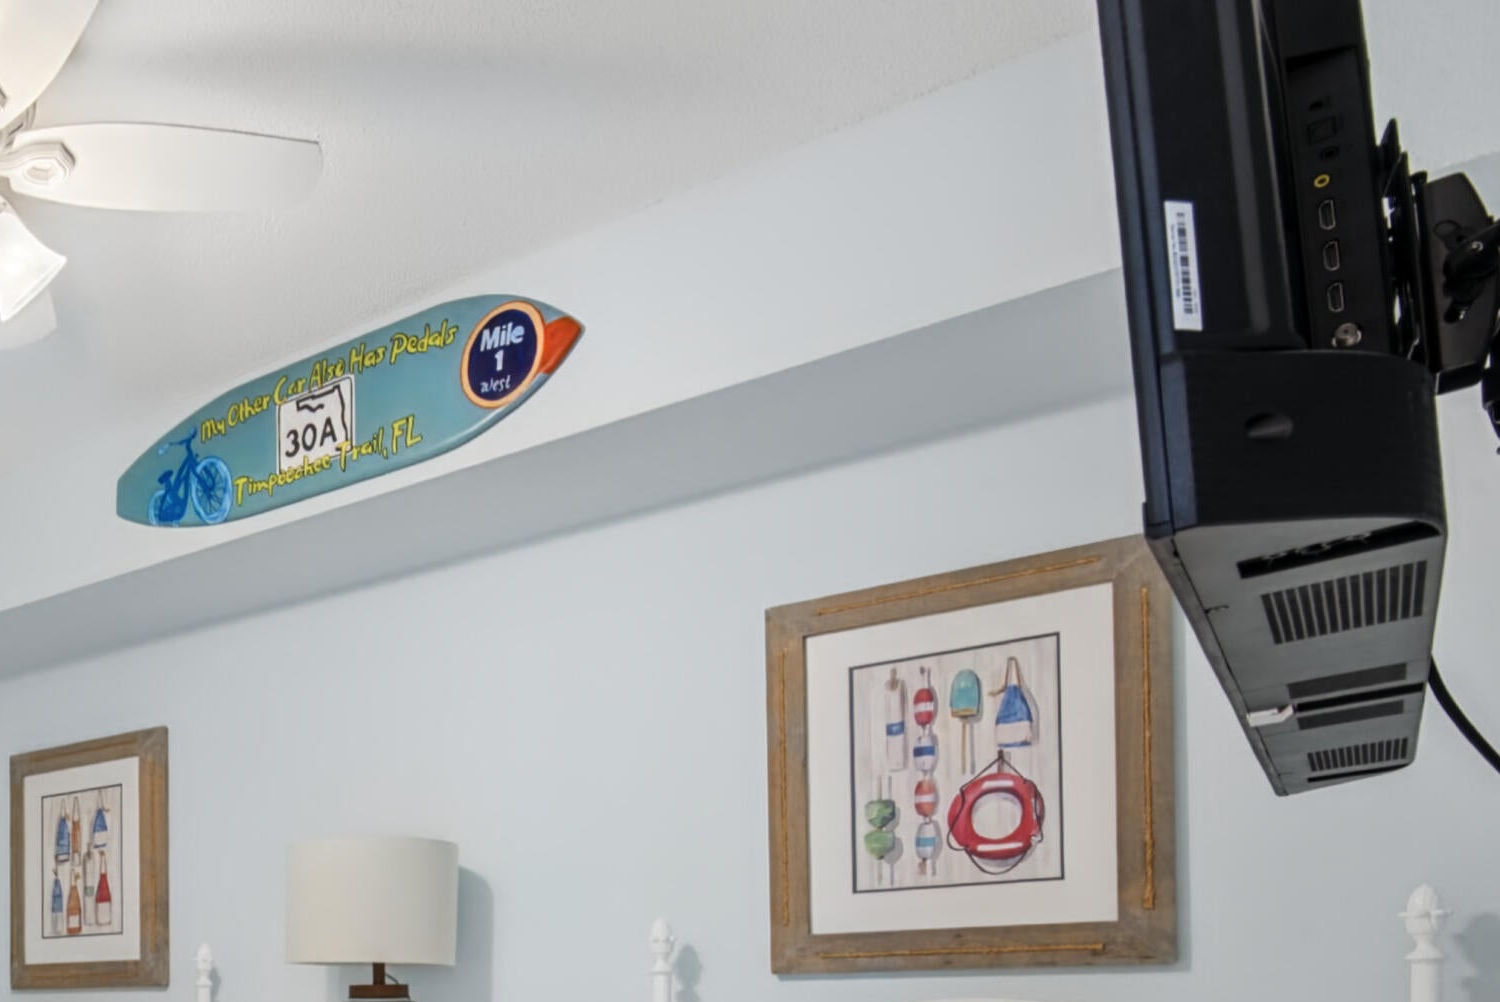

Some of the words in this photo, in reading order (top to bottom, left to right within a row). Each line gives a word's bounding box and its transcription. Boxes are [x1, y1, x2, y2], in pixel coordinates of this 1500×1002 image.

[480, 321, 525, 352] Mile
[200, 418, 226, 442] My
[227, 395, 271, 428] Other
[272, 375, 307, 406] Car
[308, 357, 345, 393] Also
[349, 342, 387, 375] Has
[390, 318, 459, 365] Pedals
[494, 349, 504, 372] 1
[285, 416, 338, 458] 30A
[336, 427, 388, 473] Trail,
[392, 414, 424, 455] FL
